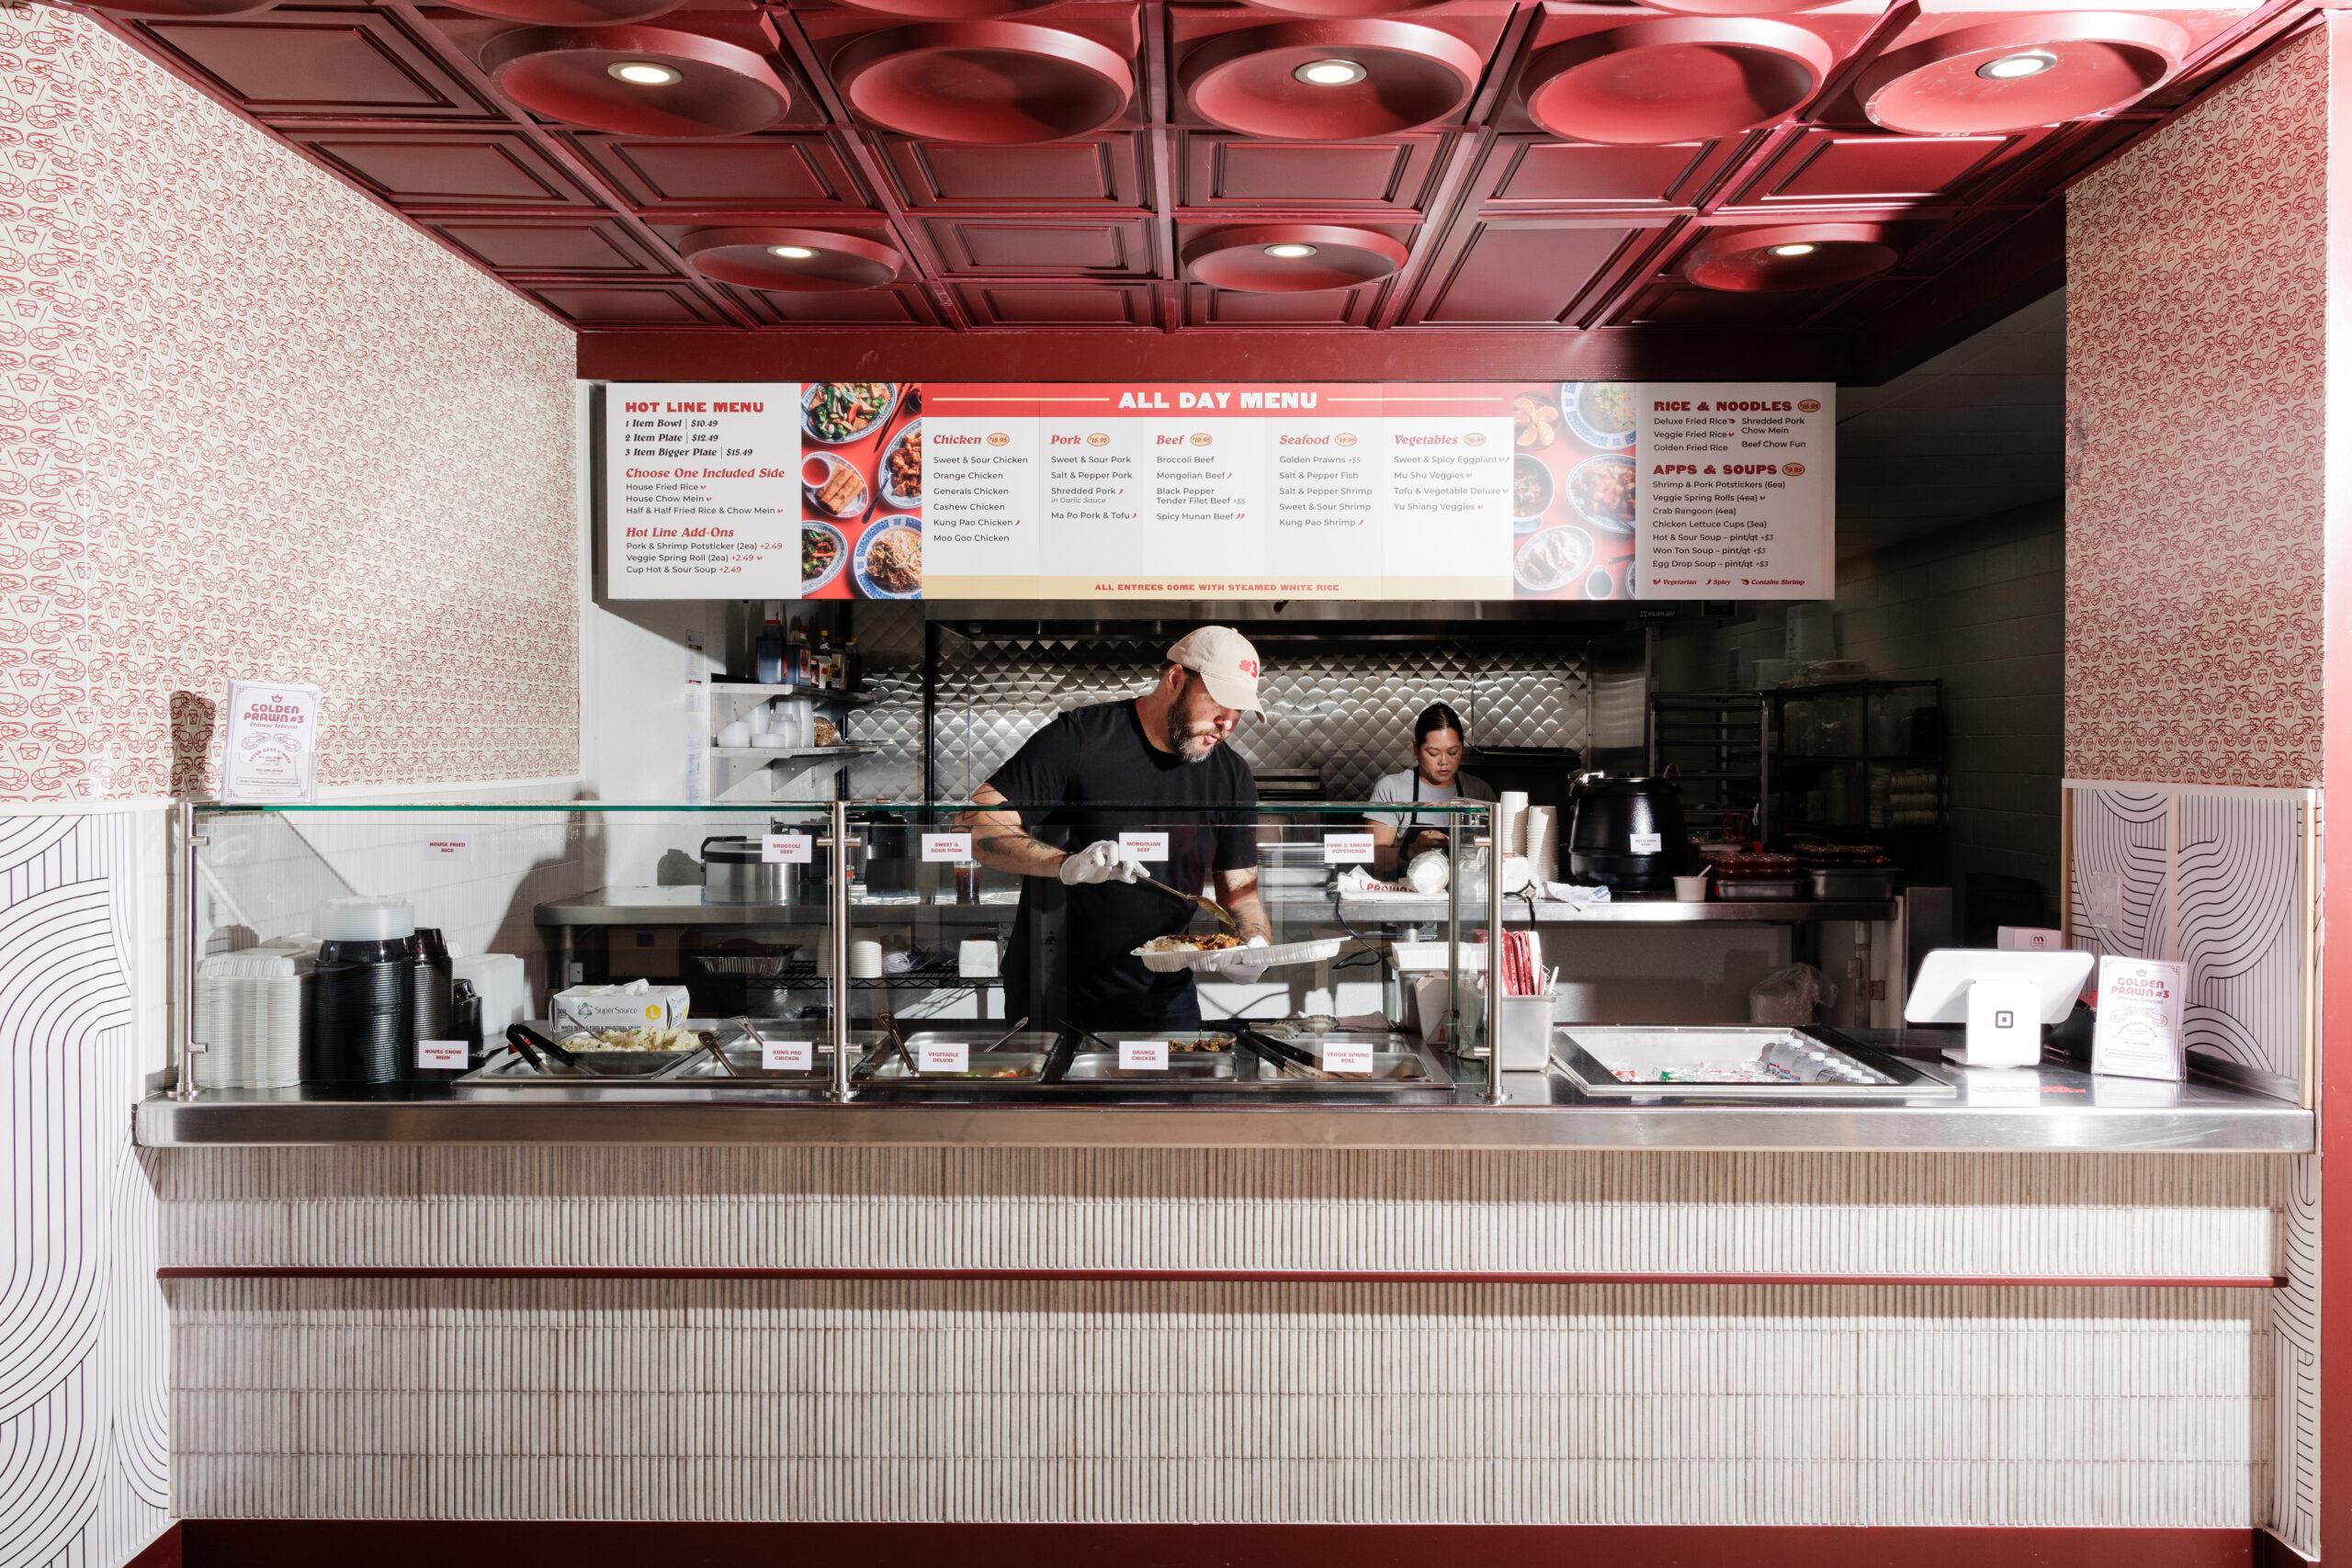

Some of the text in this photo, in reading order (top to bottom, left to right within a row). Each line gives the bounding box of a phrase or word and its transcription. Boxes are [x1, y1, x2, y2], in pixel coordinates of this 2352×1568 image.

[1118, 392, 1317, 409] ALL DAY MENU
[625, 402, 764, 413] HOT LINE MENU
[1654, 401, 1691, 412] RICE
[1697, 401, 1710, 411] &
[1716, 401, 1792, 412] NOODLES
[691, 419, 718, 427] $10.49
[658, 433, 682, 441] Plate
[933, 434, 982, 444] Chicken
[1051, 435, 1081, 445] Pork
[1156, 435, 1185, 445] Beef
[1279, 434, 1330, 445] Seafood
[1395, 434, 1458, 447] Vegetables
[658, 448, 690, 458] Bigger
[726, 448, 753, 456] $15.49
[626, 468, 785, 478] Choose One Included Side
[1653, 464, 1697, 475] APPS
[1703, 465, 1717, 474] &
[1723, 464, 1777, 475] SOUPS
[933, 472, 966, 481] Orange
[1156, 472, 1203, 481] Mongolian
[1429, 471, 1464, 480] Veggies
[1675, 508, 1713, 516] Rangoon
[1715, 507, 1736, 516] (4ea)
[934, 519, 957, 528] Kung
[1279, 519, 1303, 528] Kung
[1324, 519, 1356, 527] Shrimp
[626, 527, 734, 537] Hot Line Add-Ons
[657, 542, 688, 551] Shrimp
[737, 542, 757, 551] (2ea)
[1239, 659, 1257, 678] #3
[251, 703, 299, 714] GOLDEN
[244, 712, 304, 723] PRAWN #3
[2117, 977, 2164, 989] GOLDEN
[2111, 986, 2169, 998] PRAWN #3
[651, 1006, 657, 1017] L
